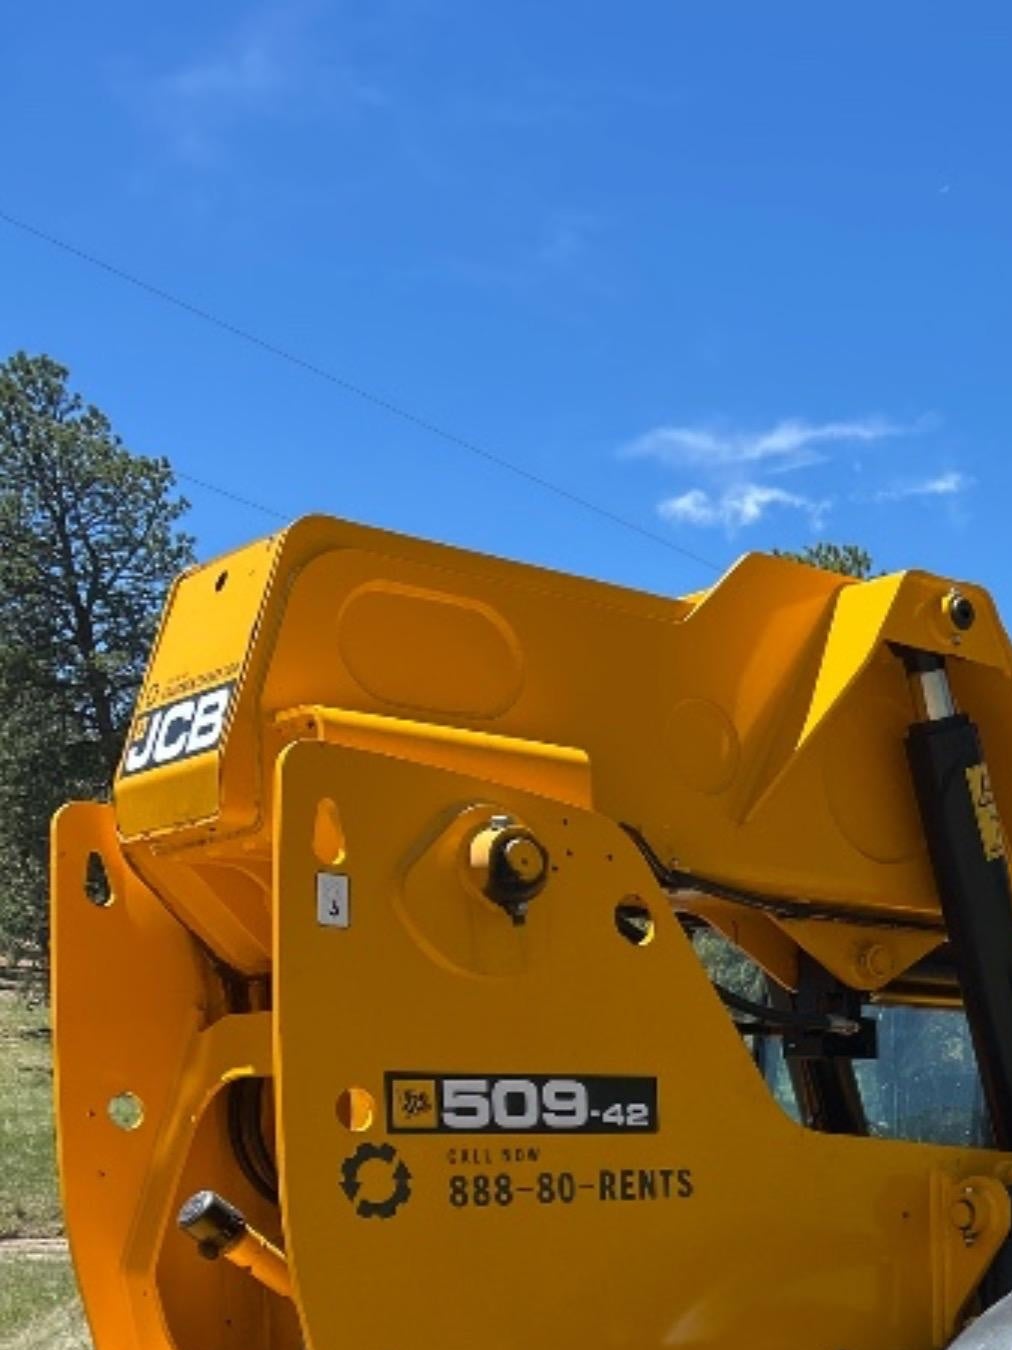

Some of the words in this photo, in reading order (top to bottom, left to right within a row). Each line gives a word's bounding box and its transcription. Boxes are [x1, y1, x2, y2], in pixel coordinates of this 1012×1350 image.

[124, 687, 231, 772] JCB
[441, 1078, 650, 1129] 509-42
[449, 1169, 694, 1208] 888-80-RENTS
